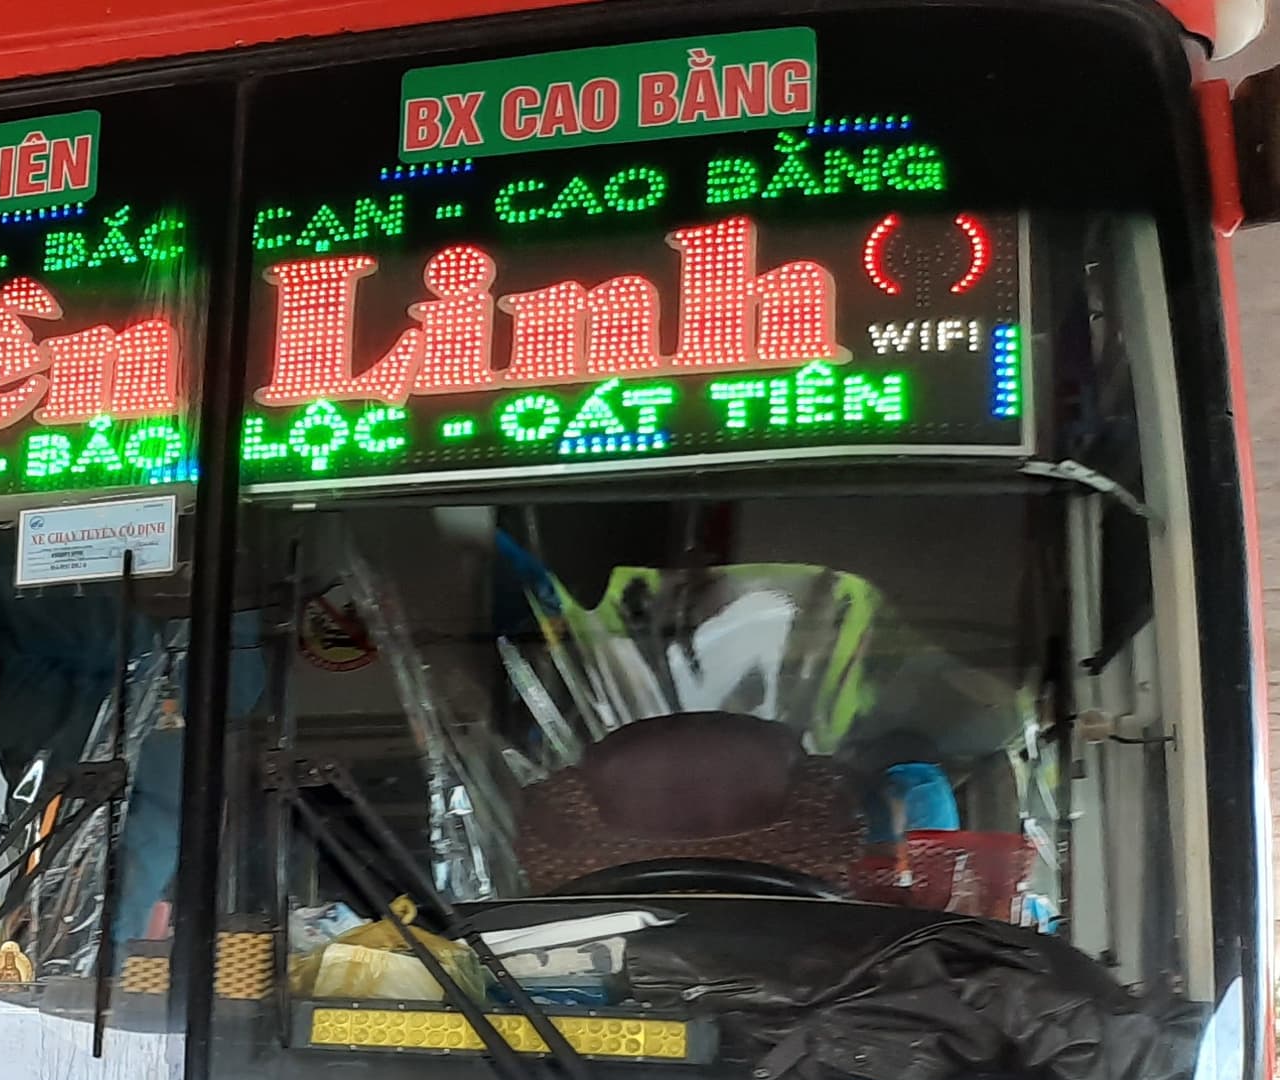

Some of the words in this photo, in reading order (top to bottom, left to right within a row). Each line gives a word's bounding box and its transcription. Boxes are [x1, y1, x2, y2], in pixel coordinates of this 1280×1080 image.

[403, 91, 484, 150] BX
[500, 77, 619, 140] CAO
[638, 48, 811, 127] BẰNG
[42, 205, 184, 271] BẮC
[495, 167, 665, 223] CAO
[706, 131, 943, 203] BẰNG
[254, 216, 853, 407] Linh
[868, 320, 980, 355] WIFI
[243, 399, 405, 471] LỘC
[710, 360, 901, 428] TIÊN
